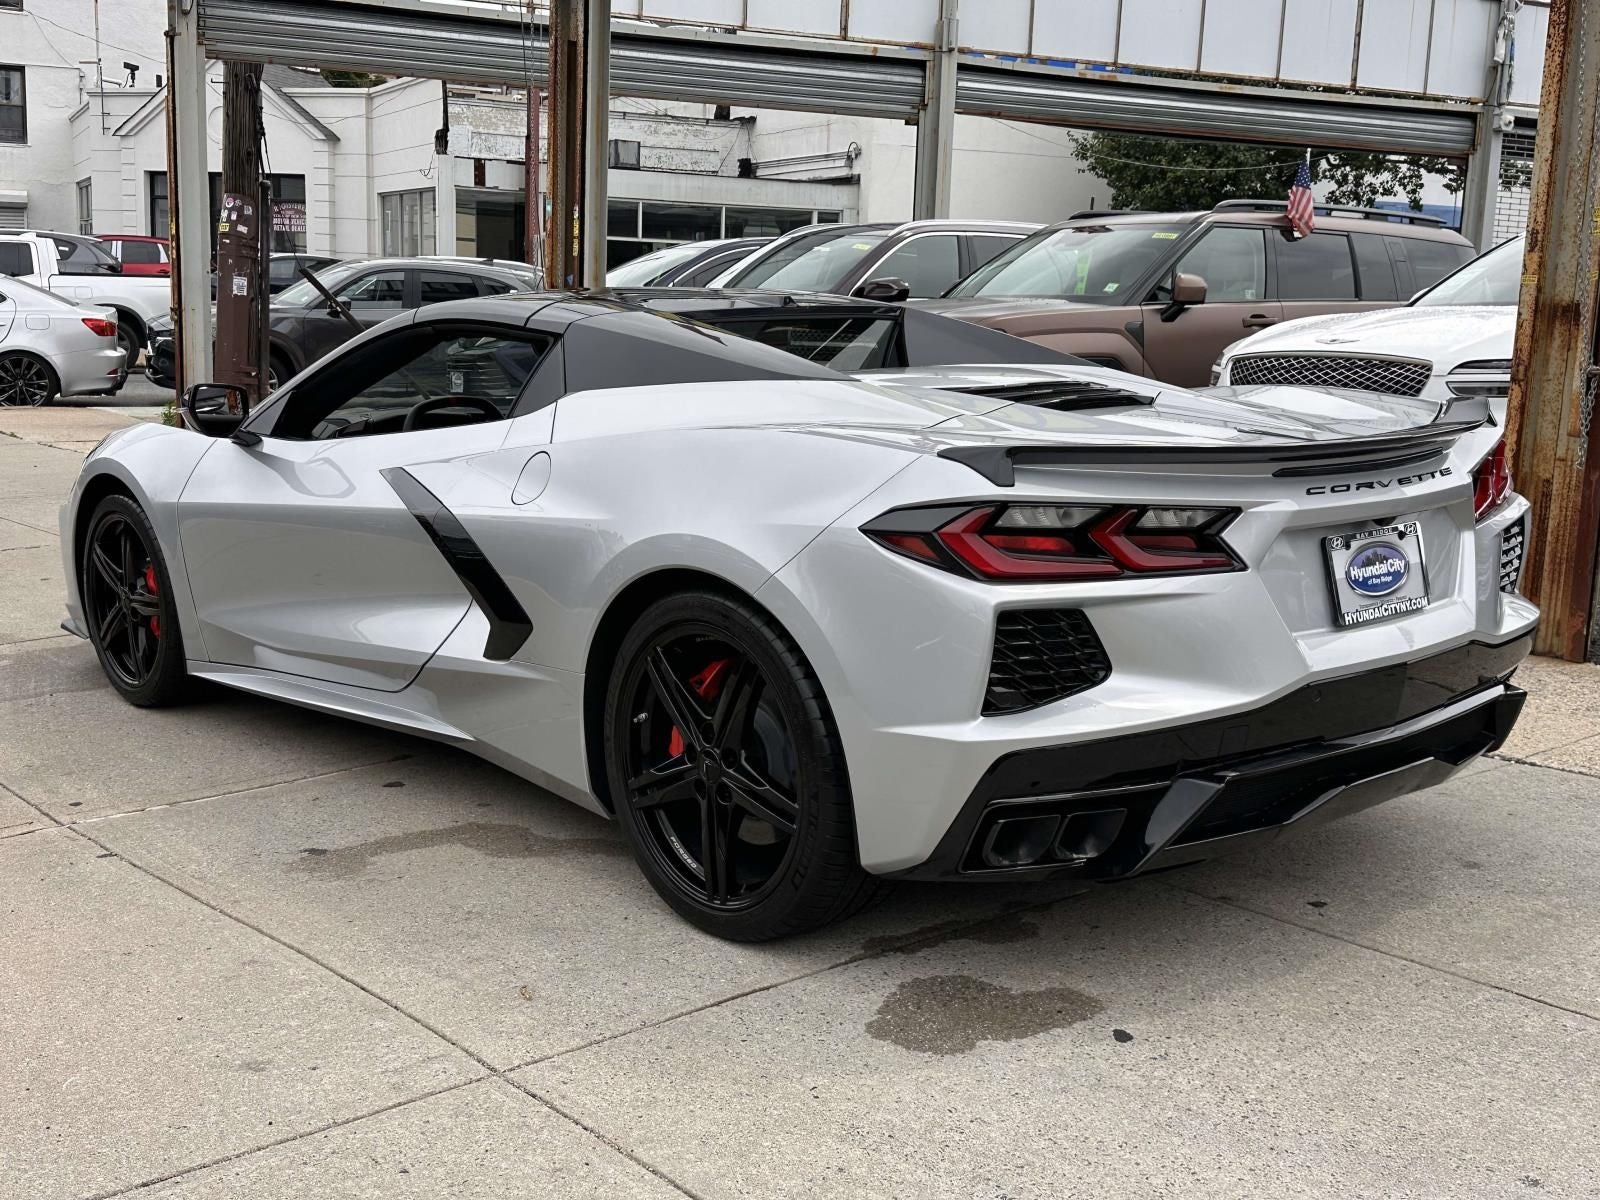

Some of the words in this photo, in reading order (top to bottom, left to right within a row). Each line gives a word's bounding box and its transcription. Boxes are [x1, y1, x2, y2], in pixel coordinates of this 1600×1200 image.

[1306, 467, 1453, 496] CORVETTE
[1356, 531, 1369, 540] BAY
[1372, 527, 1393, 537] RIDGE
[1373, 577, 1381, 585] Bay
[1380, 575, 1393, 583] Ridge
[1343, 596, 1429, 625] HYUNDAICITYNY.COM
[670, 836, 697, 868] FORGED
